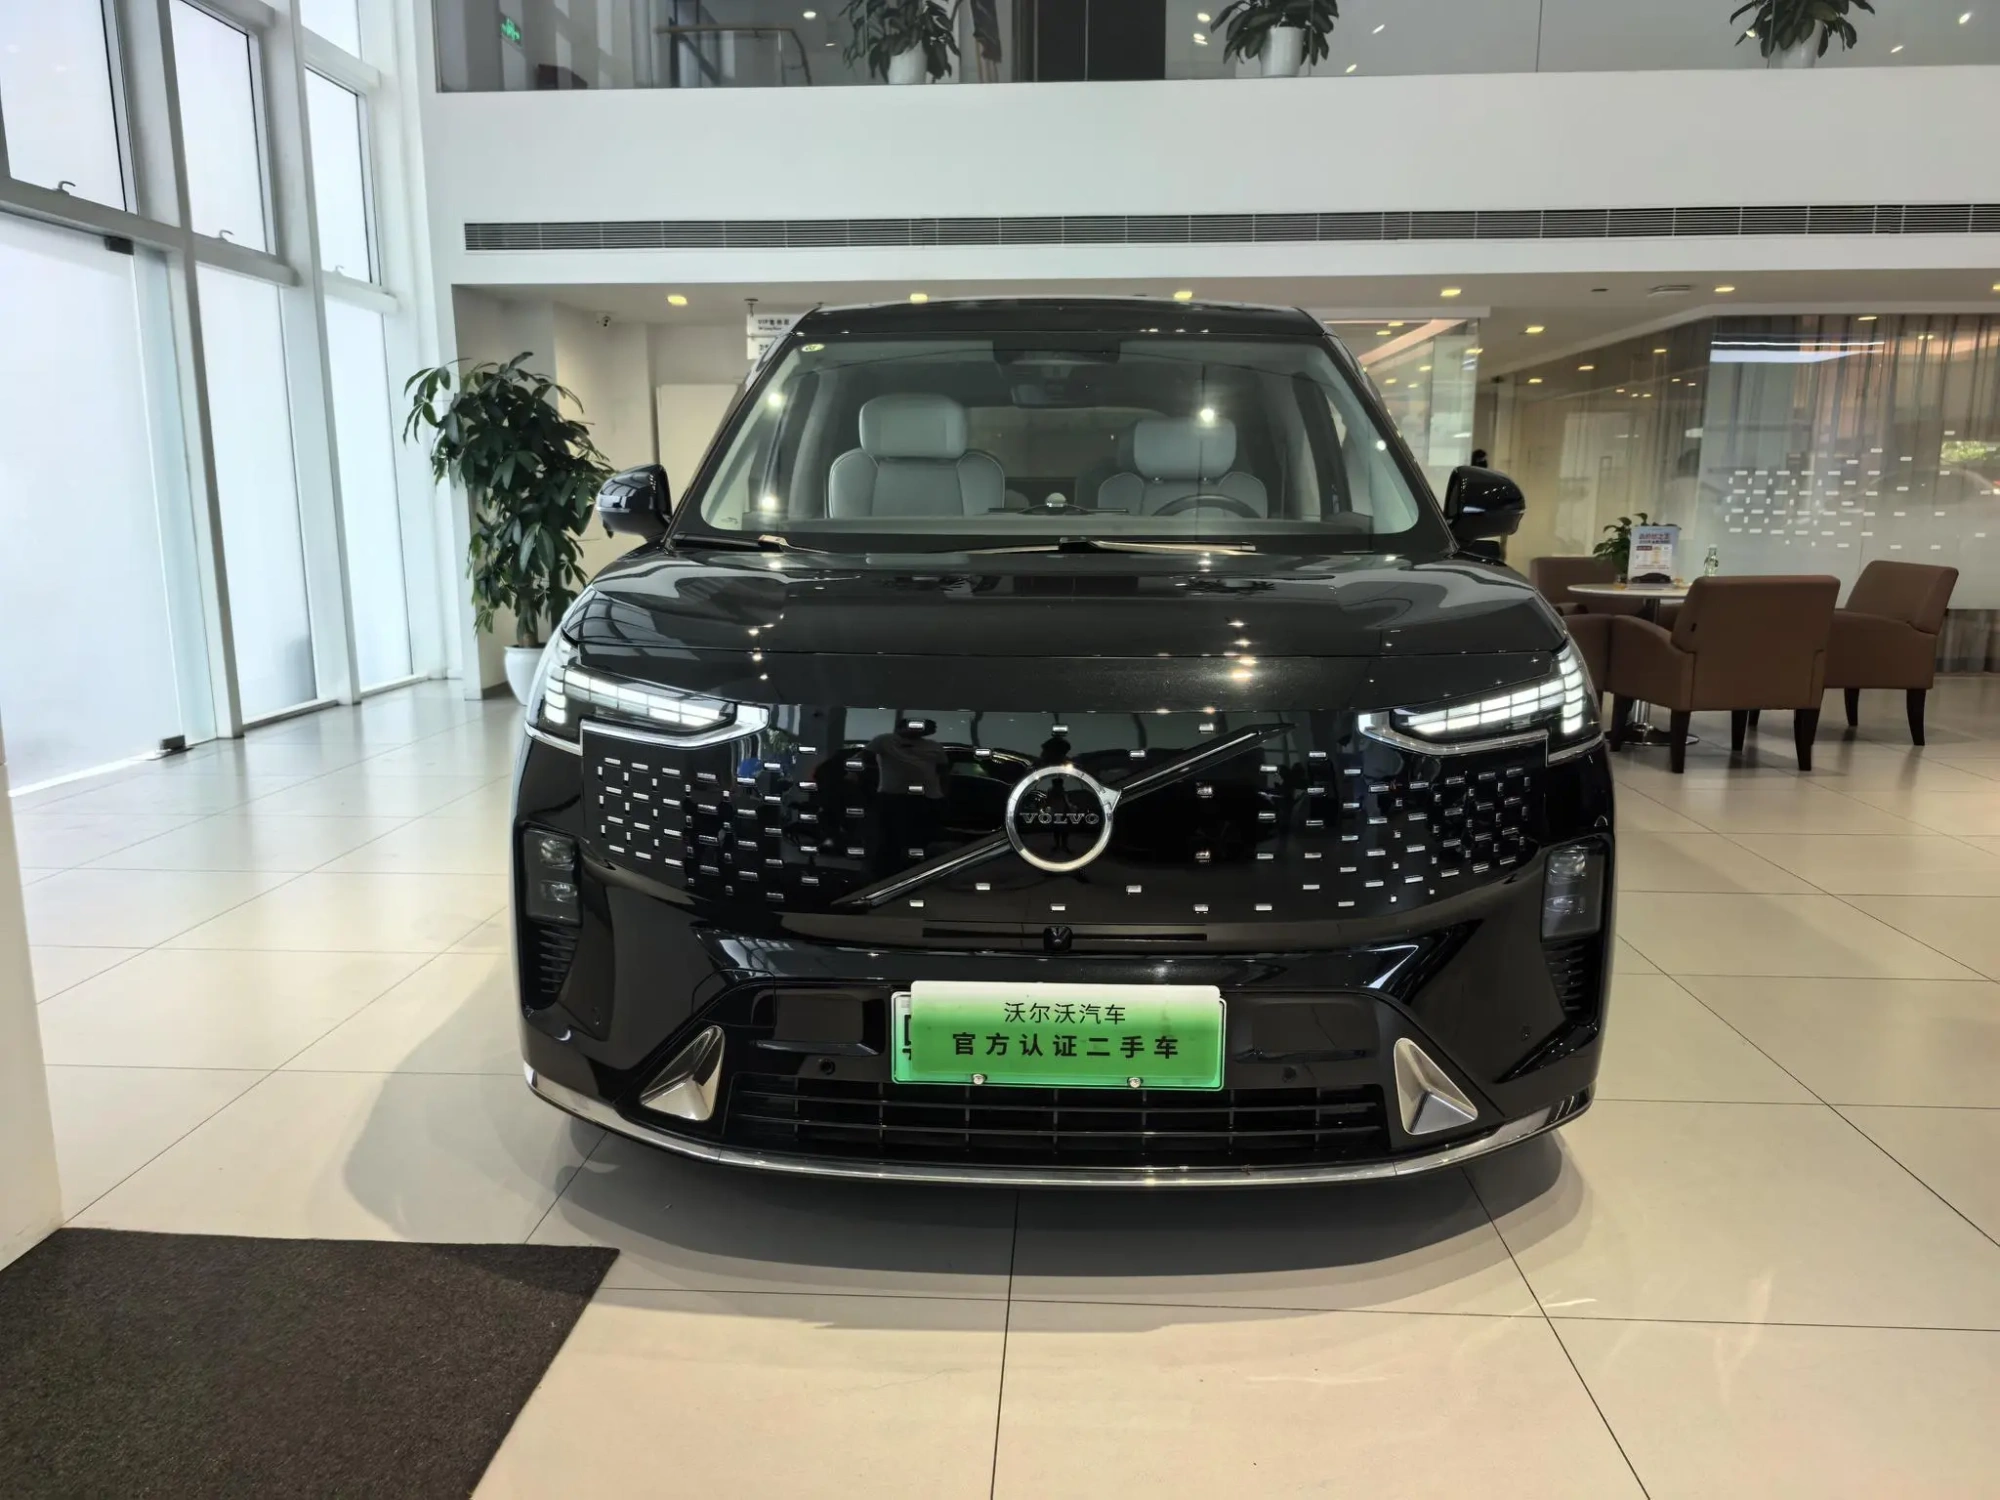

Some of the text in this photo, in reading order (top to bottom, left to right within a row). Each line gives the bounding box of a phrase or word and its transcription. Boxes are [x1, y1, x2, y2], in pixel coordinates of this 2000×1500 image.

[1020, 812, 1099, 824] VOLVO
[1003, 1002, 1126, 1024] 沃尔沃汽车
[953, 1032, 1179, 1059] 官方认证二手车
